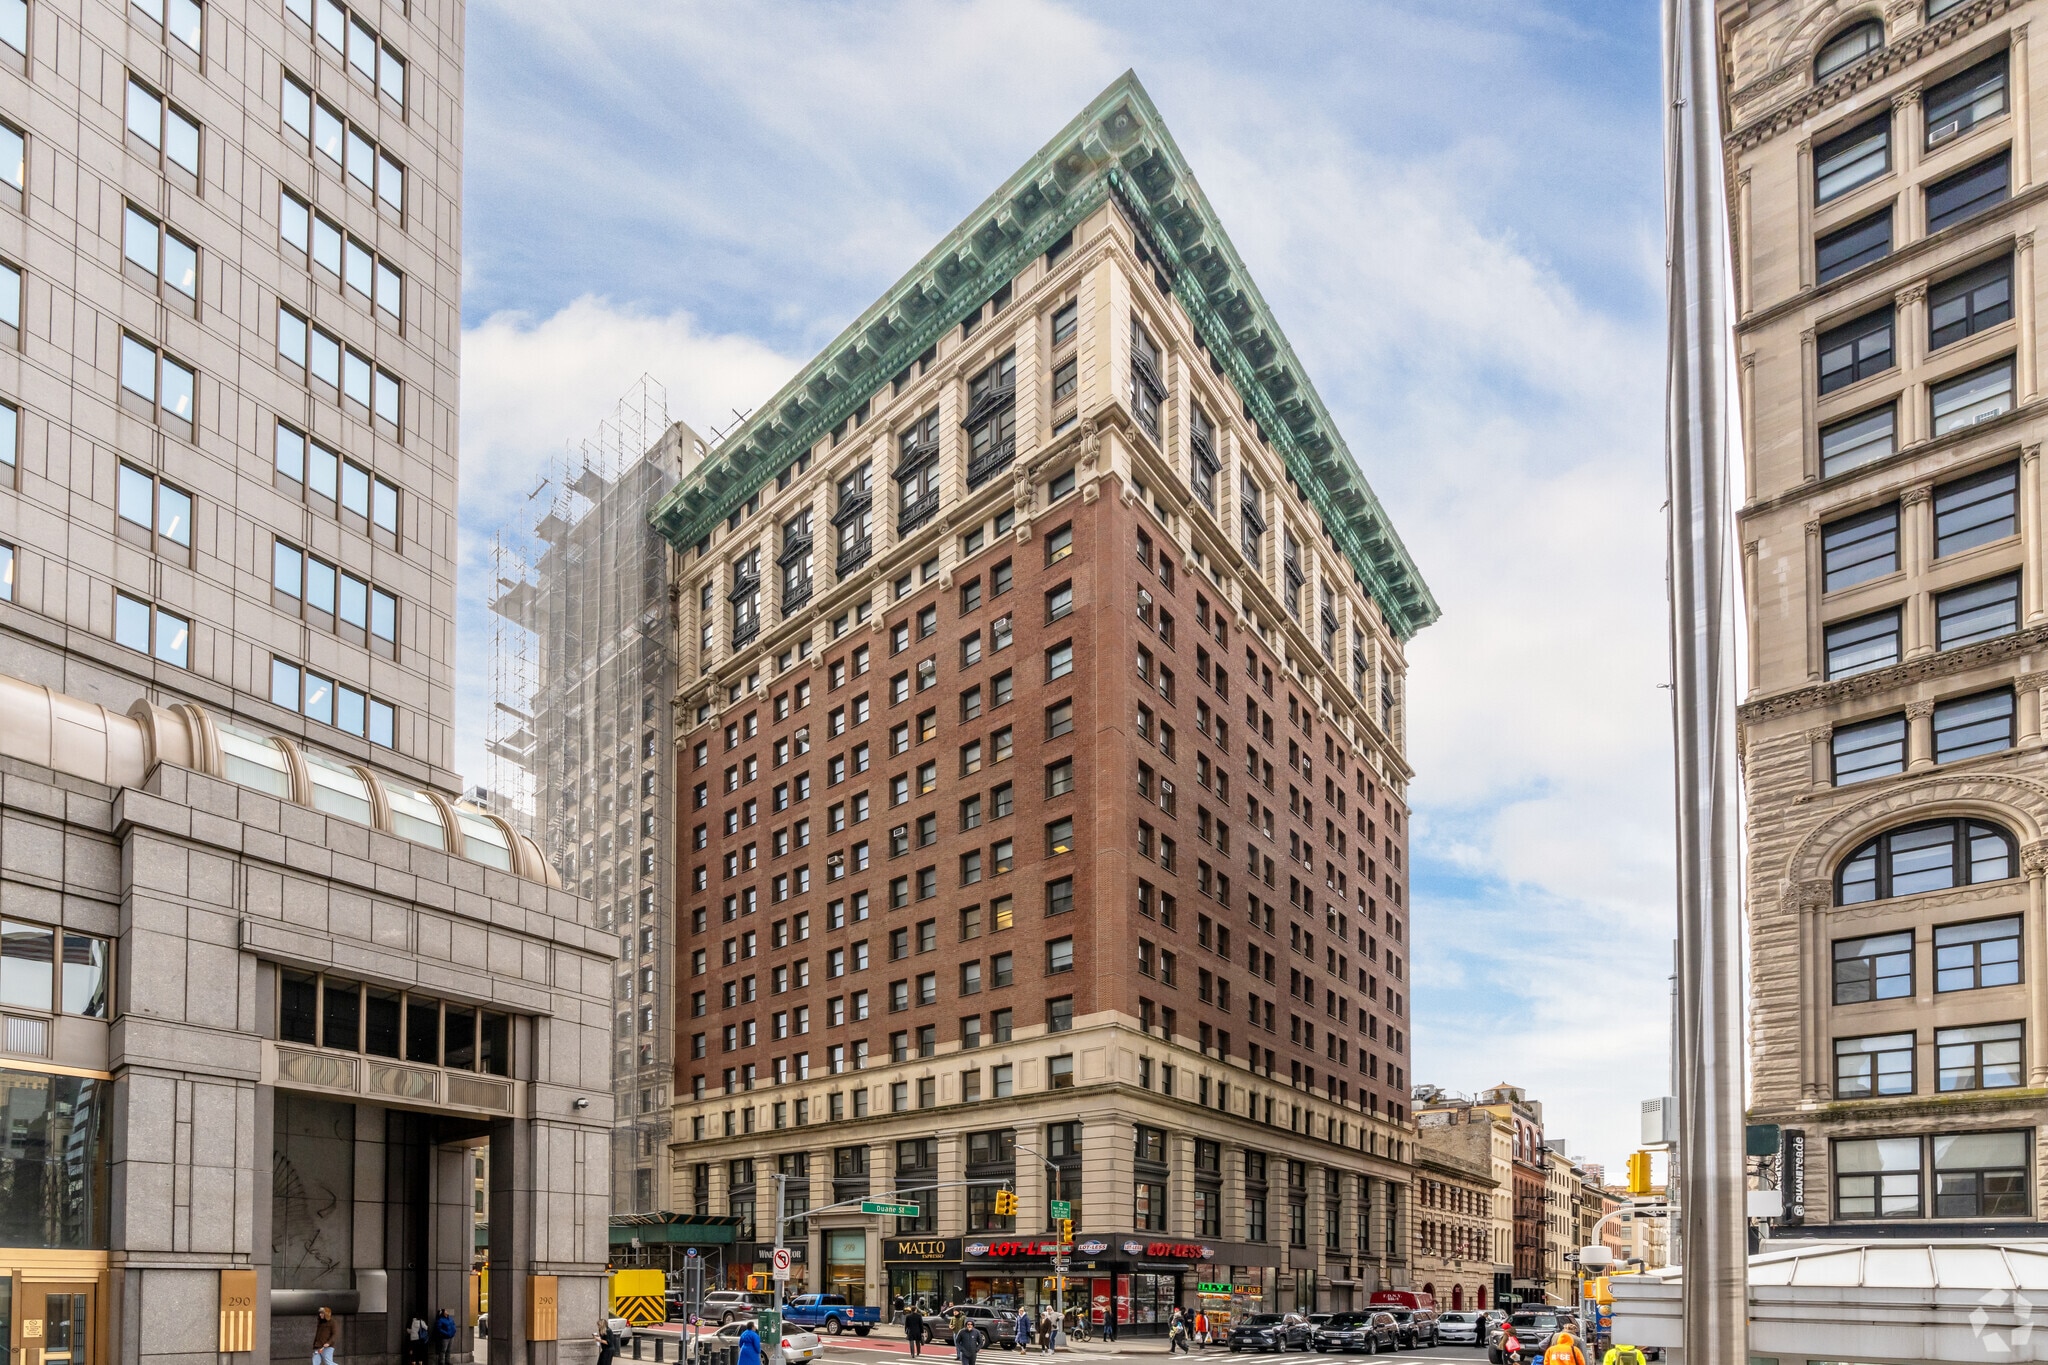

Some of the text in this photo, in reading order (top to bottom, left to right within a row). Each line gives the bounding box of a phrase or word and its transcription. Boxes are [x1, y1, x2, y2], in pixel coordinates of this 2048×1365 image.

[876, 1205, 896, 1213] Duane
[898, 1241, 946, 1255] MATTO
[1147, 1242, 1203, 1259] LOT-LESS
[228, 1296, 252, 1307] 290
[538, 1296, 554, 1305] 290
